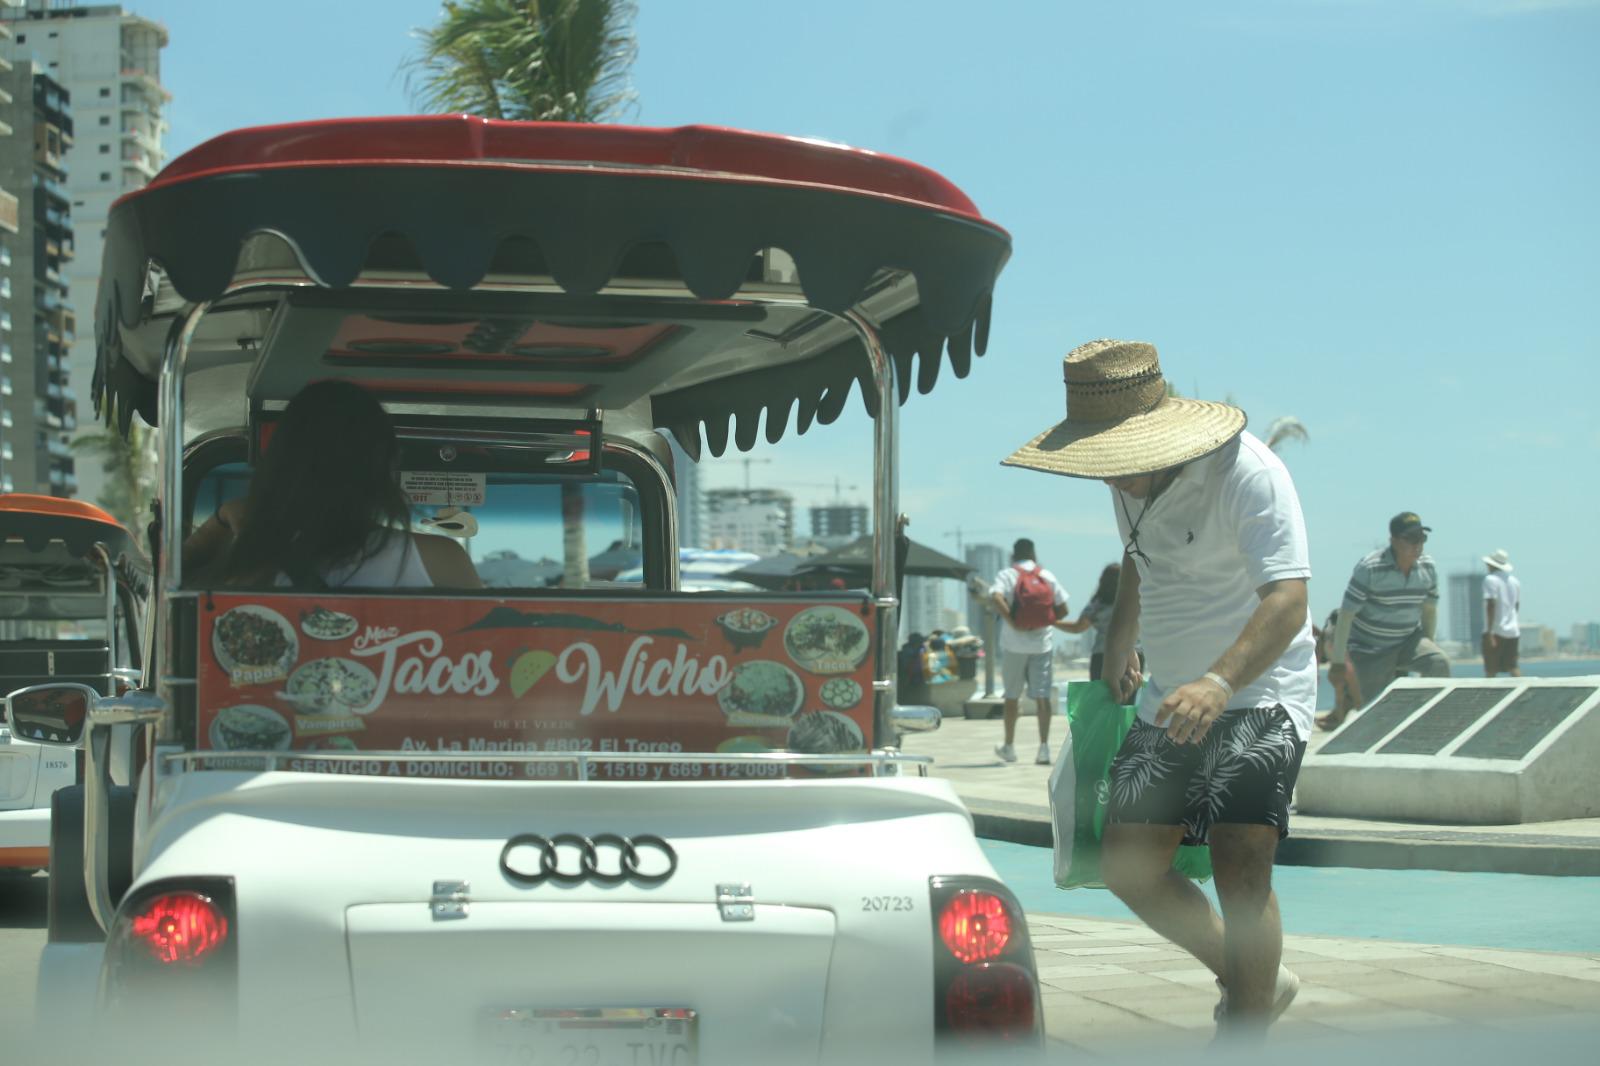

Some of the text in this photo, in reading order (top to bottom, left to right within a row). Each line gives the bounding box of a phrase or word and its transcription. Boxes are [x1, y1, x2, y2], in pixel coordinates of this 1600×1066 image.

[232, 666, 283, 684] Papas
[350, 630, 734, 716] Tacos Wicho
[402, 737, 683, 753] Av. La Marina #802 El Toreo
[290, 760, 382, 774] SERVICIO
[387, 761, 400, 775] A
[407, 761, 514, 777] DOMICILIO:
[524, 762, 559, 777] 669
[567, 762, 597, 777] 12
[604, 762, 648, 777] 1519
[653, 765, 663, 780] y
[669, 762, 702, 777] 669
[708, 762, 740, 777] 112
[861, 895, 914, 912] 20723
